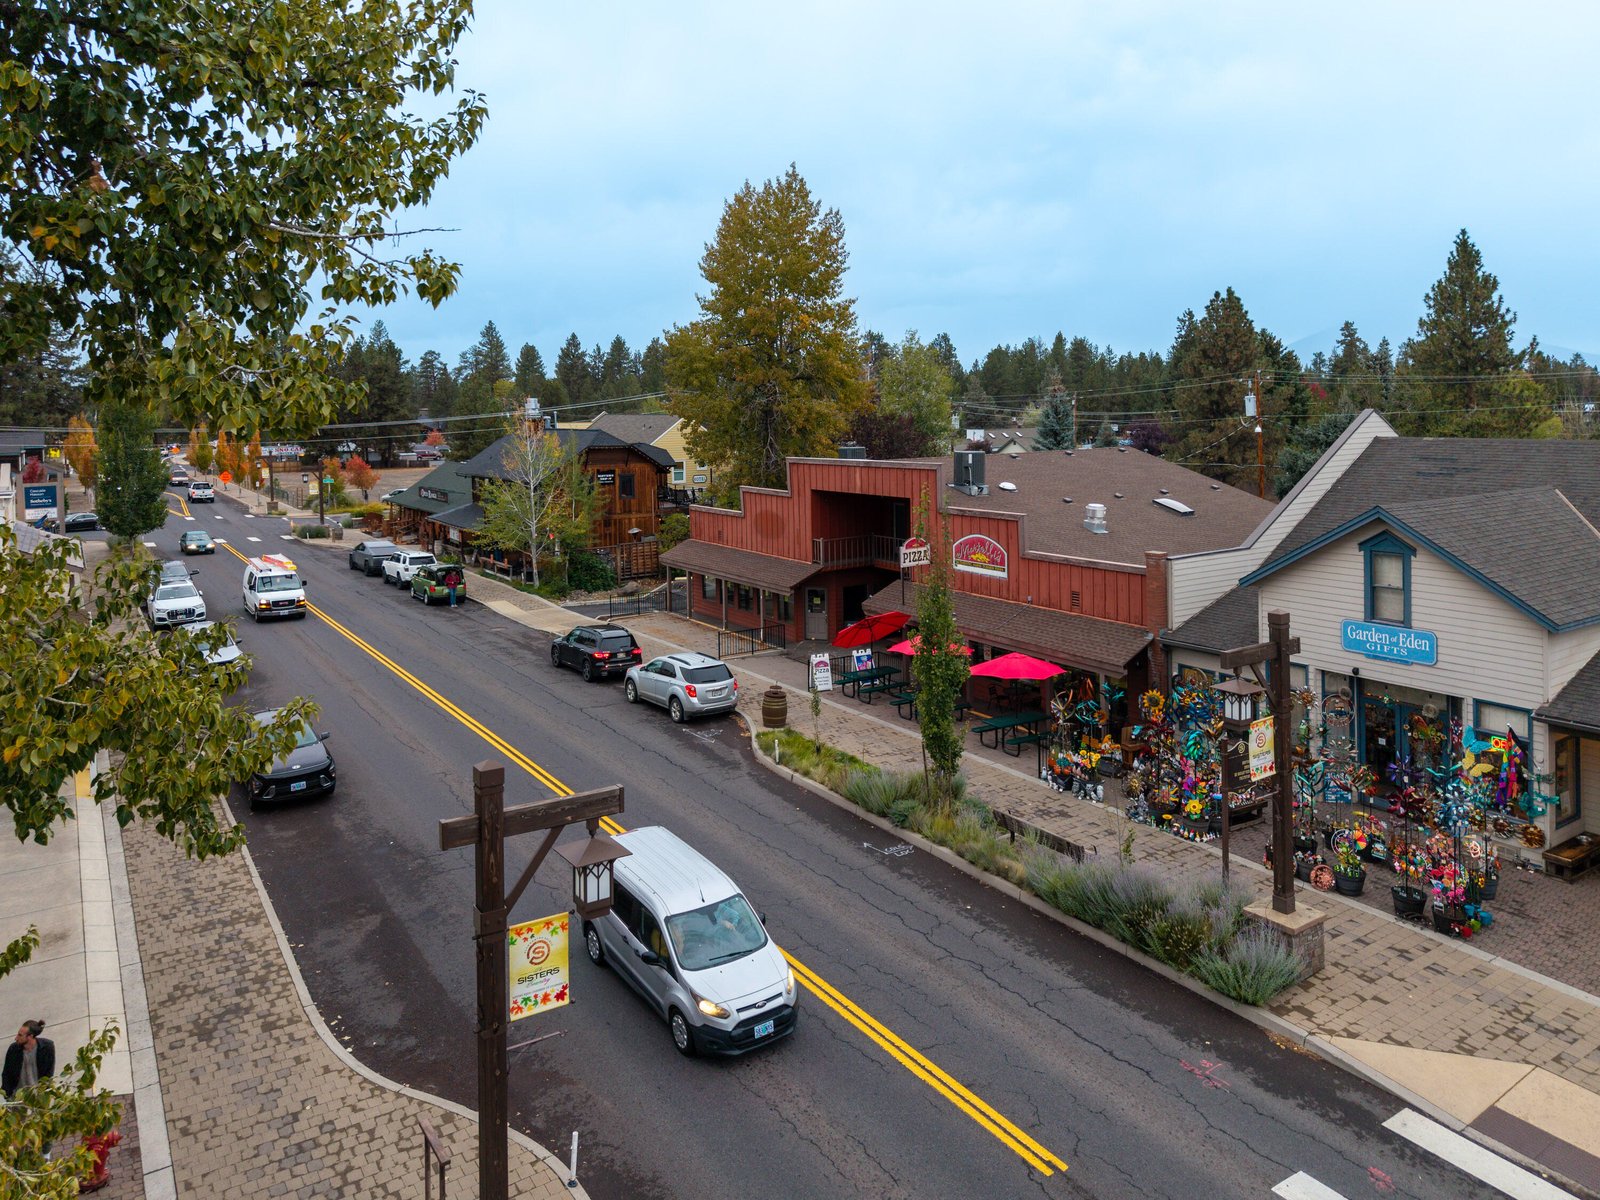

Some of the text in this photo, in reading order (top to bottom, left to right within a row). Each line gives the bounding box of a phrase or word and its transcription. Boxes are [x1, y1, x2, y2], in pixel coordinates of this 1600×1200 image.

[903, 549, 929, 564] PIZZA
[1347, 625, 1389, 644] Garden
[1399, 632, 1430, 651] Eden
[1366, 643, 1408, 656] GIFTS
[517, 966, 560, 985] SISTERS
